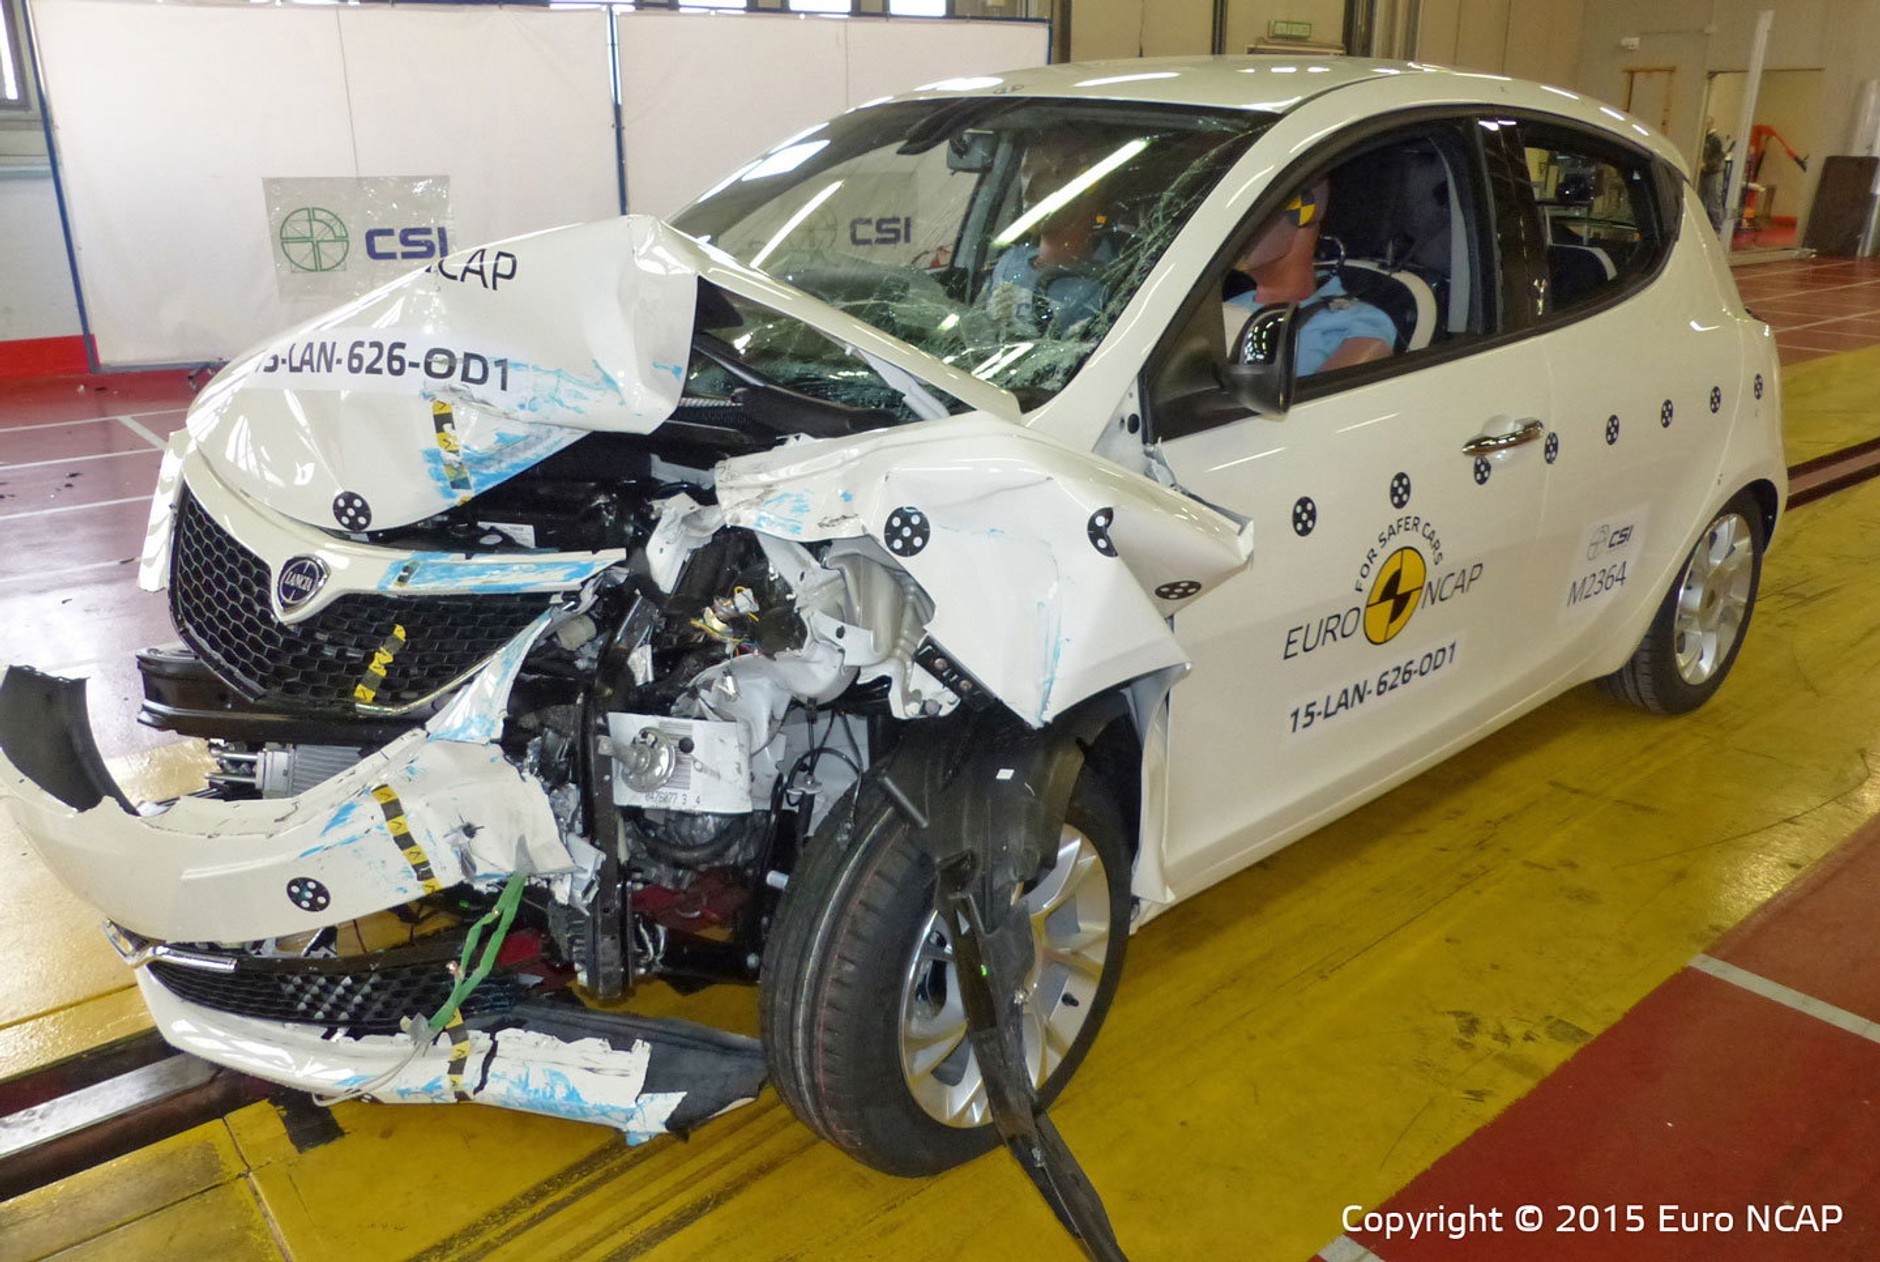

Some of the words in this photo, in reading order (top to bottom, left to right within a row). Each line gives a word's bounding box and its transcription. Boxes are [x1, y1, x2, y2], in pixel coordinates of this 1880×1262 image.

[365, 226, 448, 260] CSI
[850, 216, 911, 246] CSI
[1608, 524, 1634, 548] CSI
[1355, 548, 1378, 593] FOR
[1378, 516, 1421, 548] SAFER
[1421, 522, 1444, 566] CARS
[284, 571, 314, 592] LANCIA
[1566, 561, 1627, 607] M2364
[1283, 606, 1361, 660] EURO
[1420, 563, 1484, 610] NCAP
